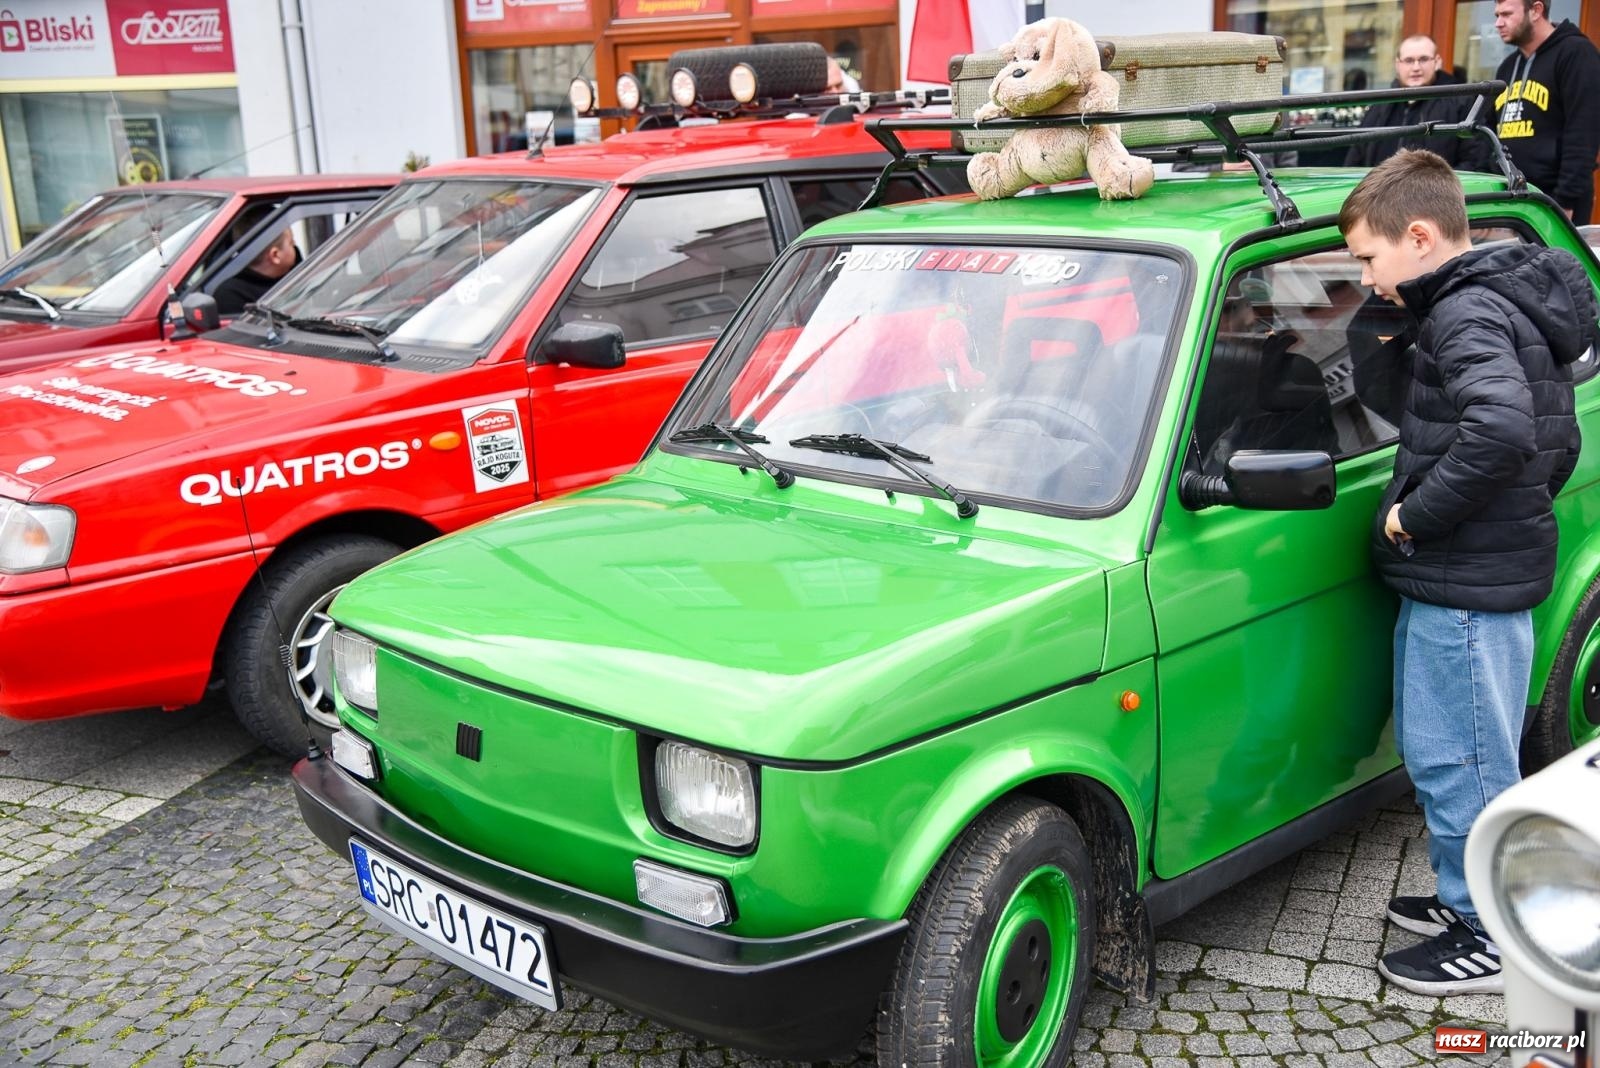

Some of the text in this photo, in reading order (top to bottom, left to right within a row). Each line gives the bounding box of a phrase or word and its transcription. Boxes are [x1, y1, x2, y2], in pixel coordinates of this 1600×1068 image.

[25, 15, 94, 42] Bliski
[828, 249, 1081, 284] POLSKI FIAT 126p
[474, 415, 510, 427] NOVOL
[477, 451, 520, 467] RAJD KOGUTA
[490, 463, 511, 475] 2025
[363, 859, 548, 989] PL SRC 01472
